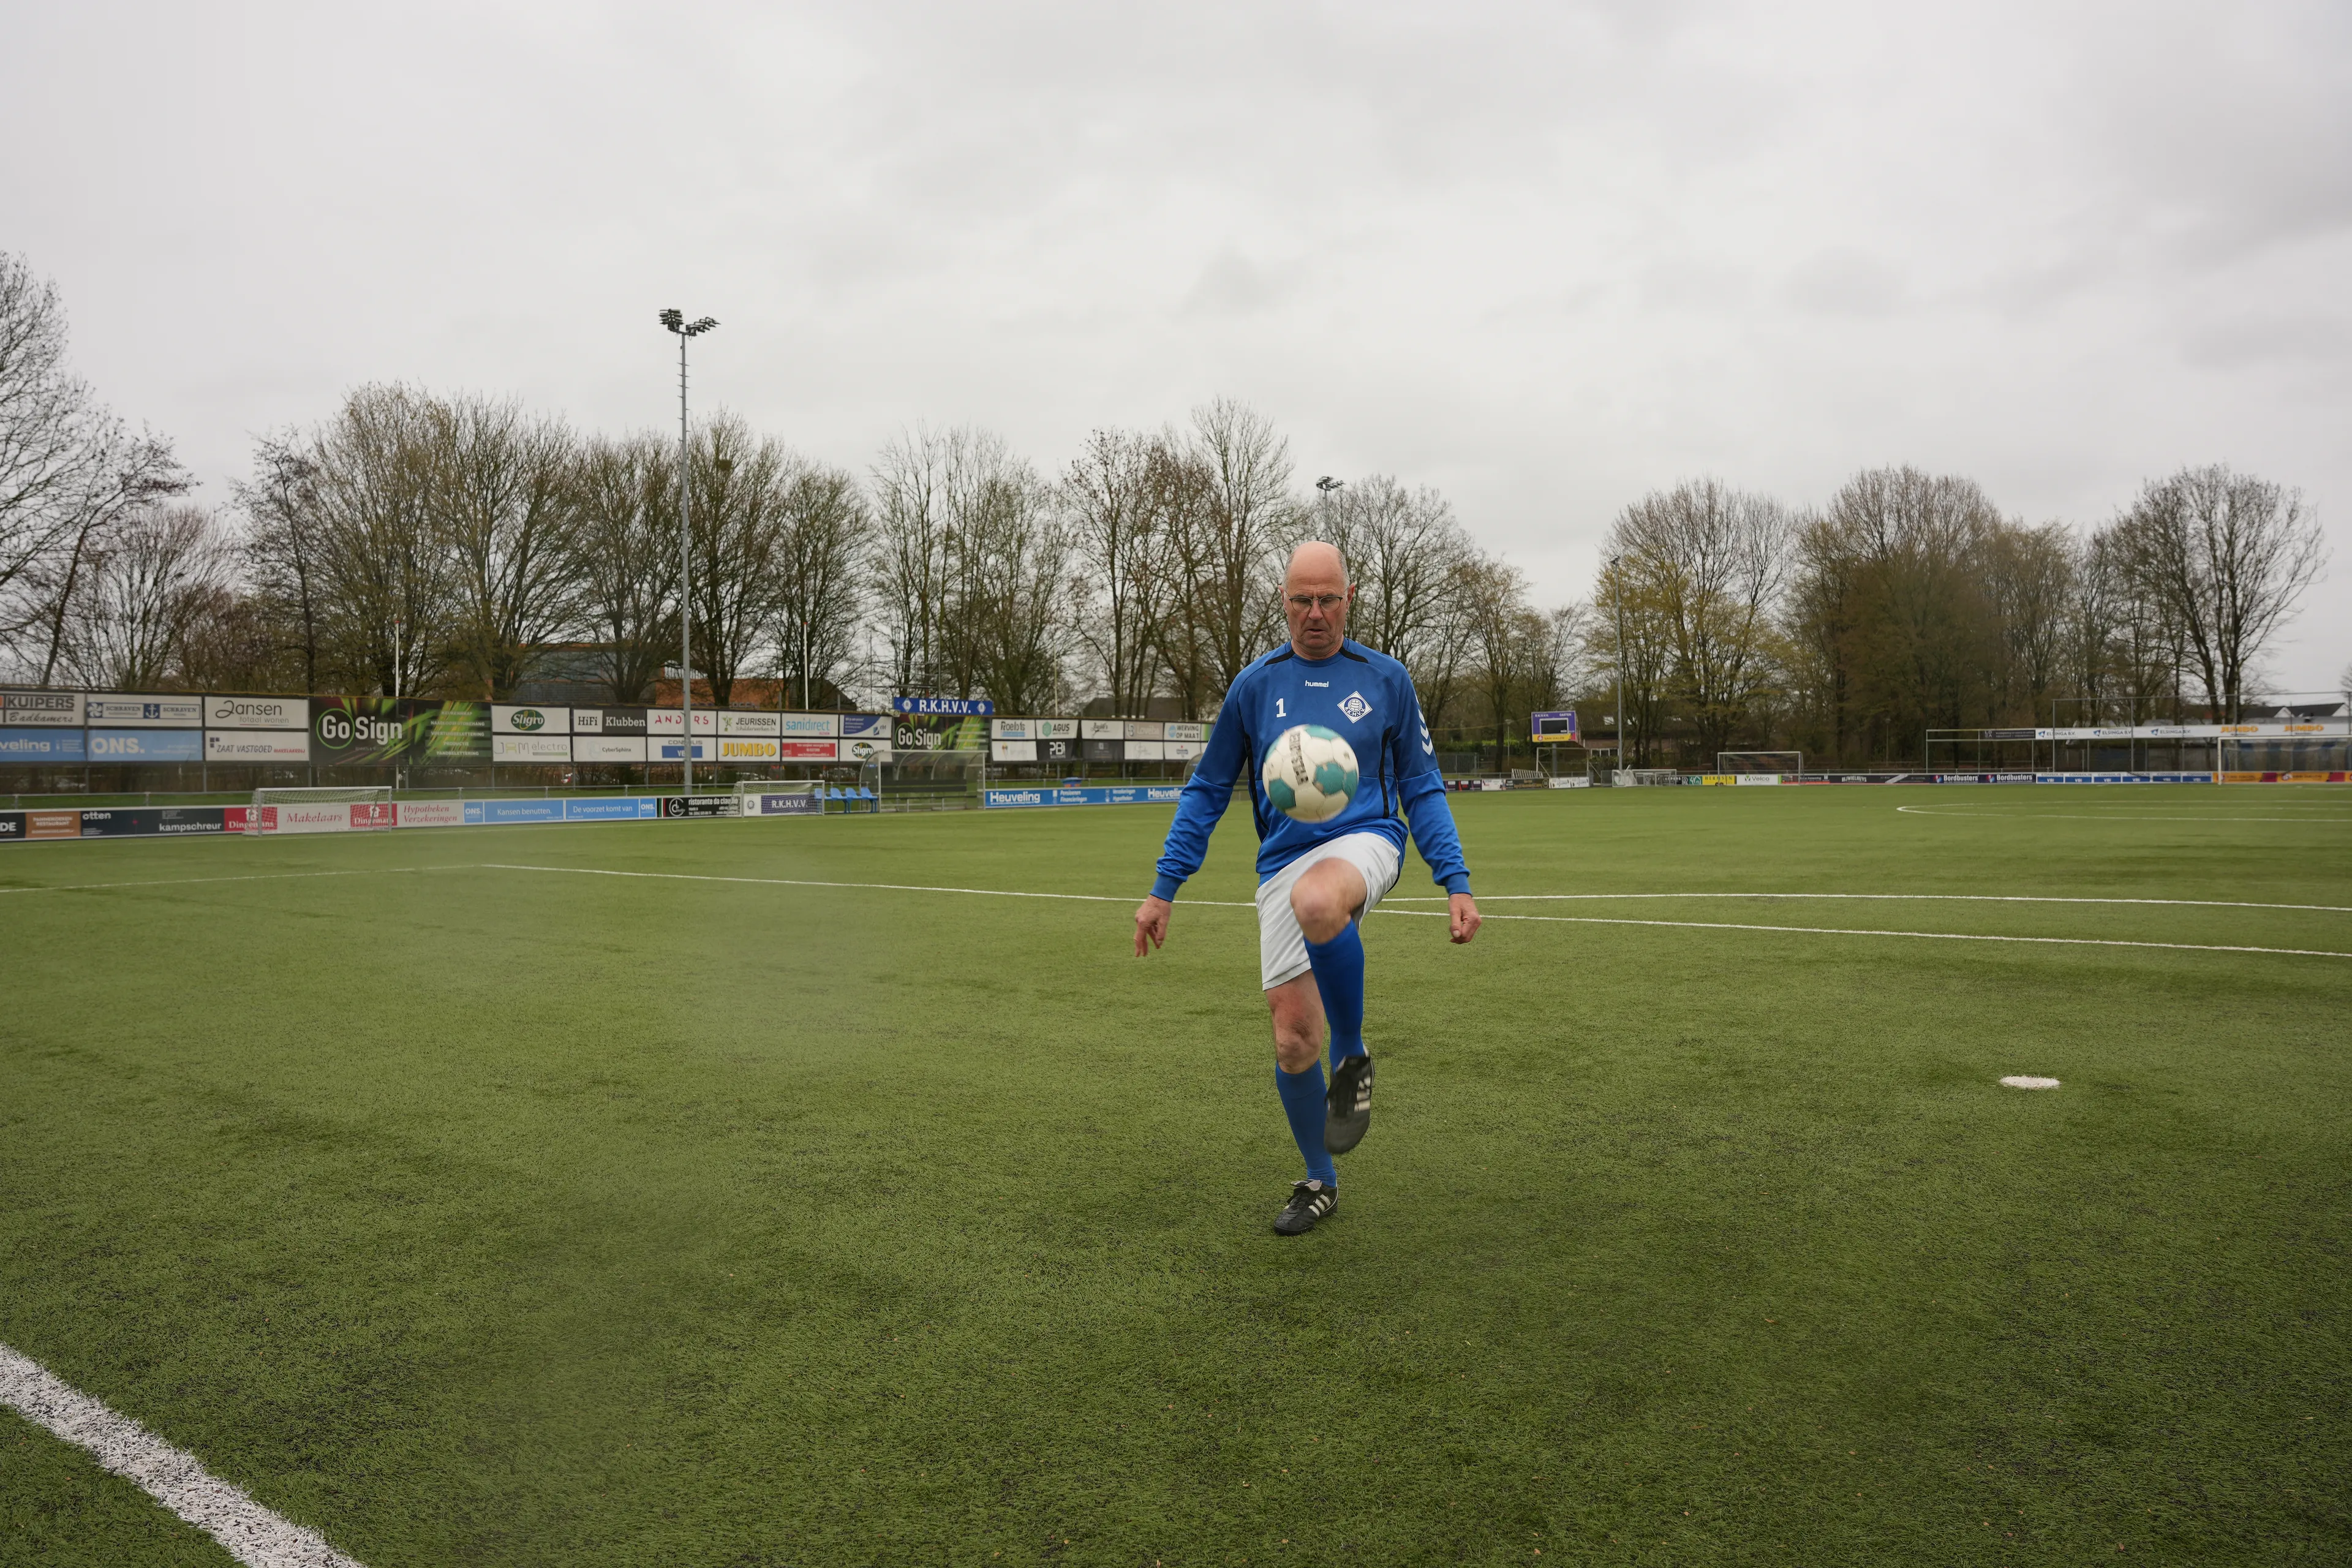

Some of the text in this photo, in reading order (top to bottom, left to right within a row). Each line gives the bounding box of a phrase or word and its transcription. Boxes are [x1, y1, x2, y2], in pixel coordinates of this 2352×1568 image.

[7, 696, 75, 708] KUIPERS
[919, 699, 971, 714] R.K.H.V.V.
[216, 700, 282, 718] Jansen
[1276, 698, 1286, 718] 1
[9, 712, 73, 723] Badkamers
[513, 715, 545, 726] Sligro
[578, 716, 646, 727] HiFi Klubben
[655, 715, 709, 725] ANDRS
[786, 718, 831, 731] sanidirect
[91, 737, 145, 755] ONS.
[237, 745, 273, 753] VASTGOED
[532, 741, 567, 751] electro
[722, 742, 777, 757] JUMBO
[852, 745, 873, 755] Sligro
[990, 791, 1041, 803] Heuveling
[404, 805, 450, 814] Hypotheken
[522, 807, 552, 815] benutten.
[82, 812, 111, 820] otten
[287, 812, 343, 823] Makelaars
[404, 814, 458, 824] Verzekeringen
[159, 822, 222, 832] kampschreur
